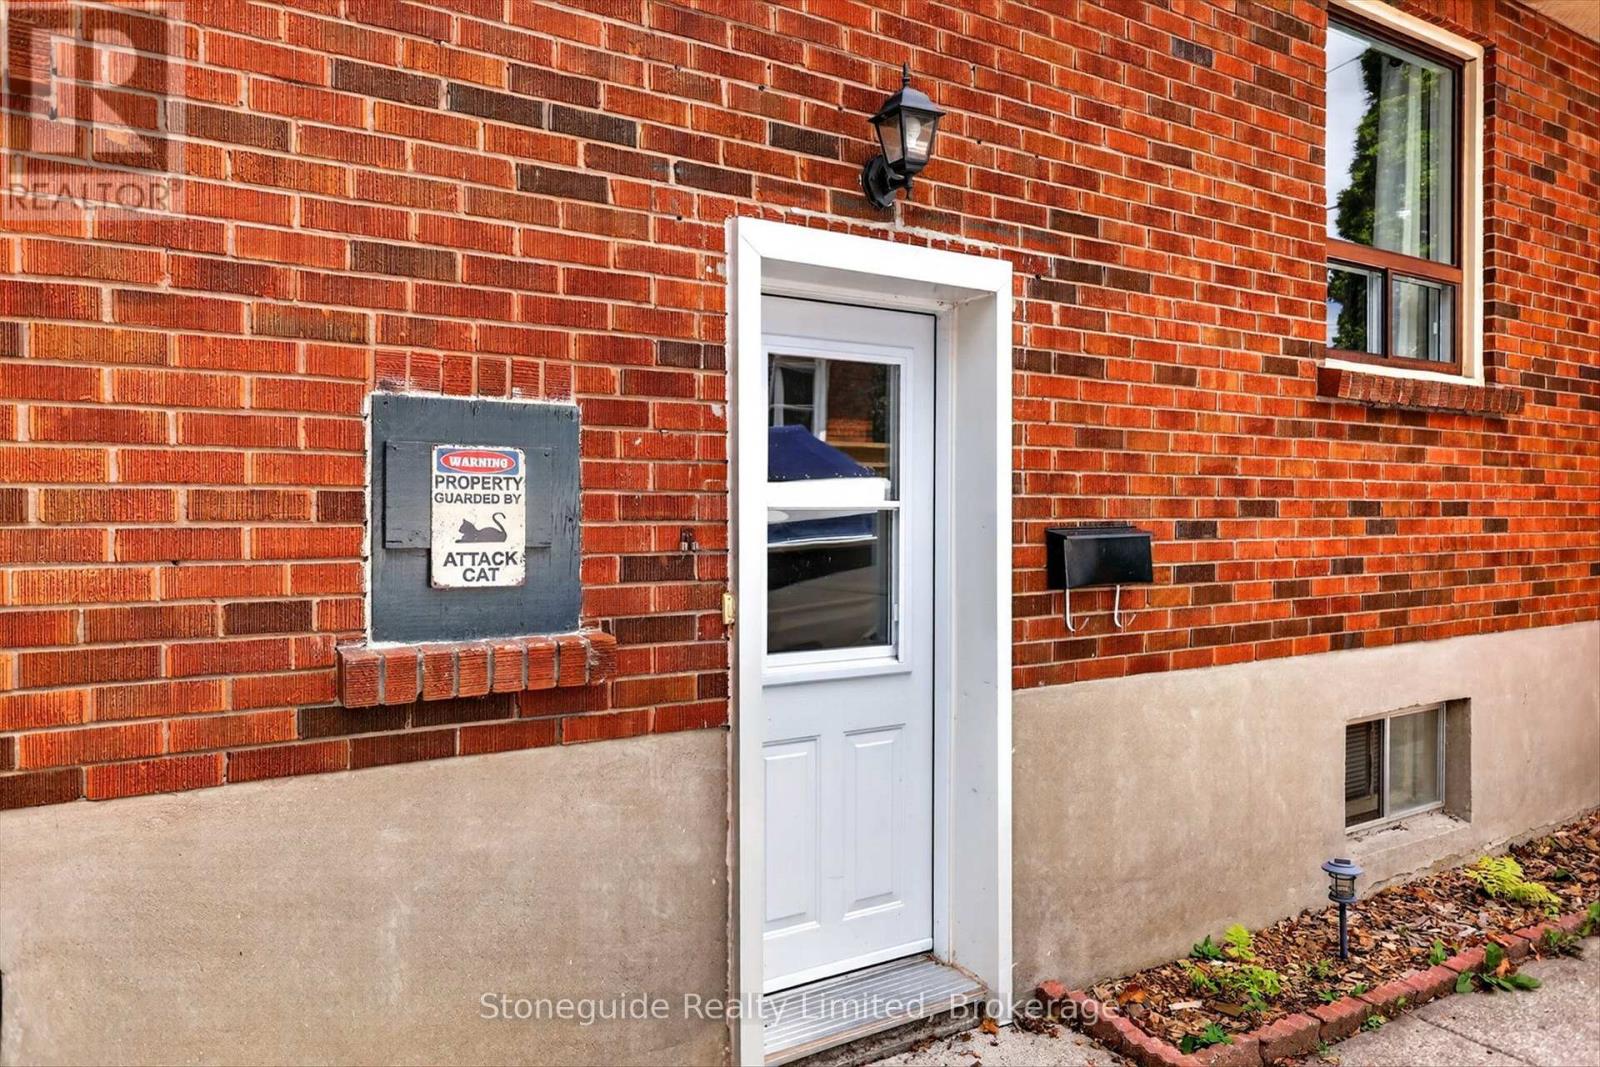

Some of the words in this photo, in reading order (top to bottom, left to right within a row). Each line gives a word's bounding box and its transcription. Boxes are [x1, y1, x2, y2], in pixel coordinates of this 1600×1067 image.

[449, 455, 509, 469] WARNING
[434, 474, 523, 491] PROPERTY
[434, 492, 500, 505] GUARDED
[504, 493, 521, 505] BY
[443, 551, 518, 567] ATTACK
[462, 568, 500, 582] CAT
